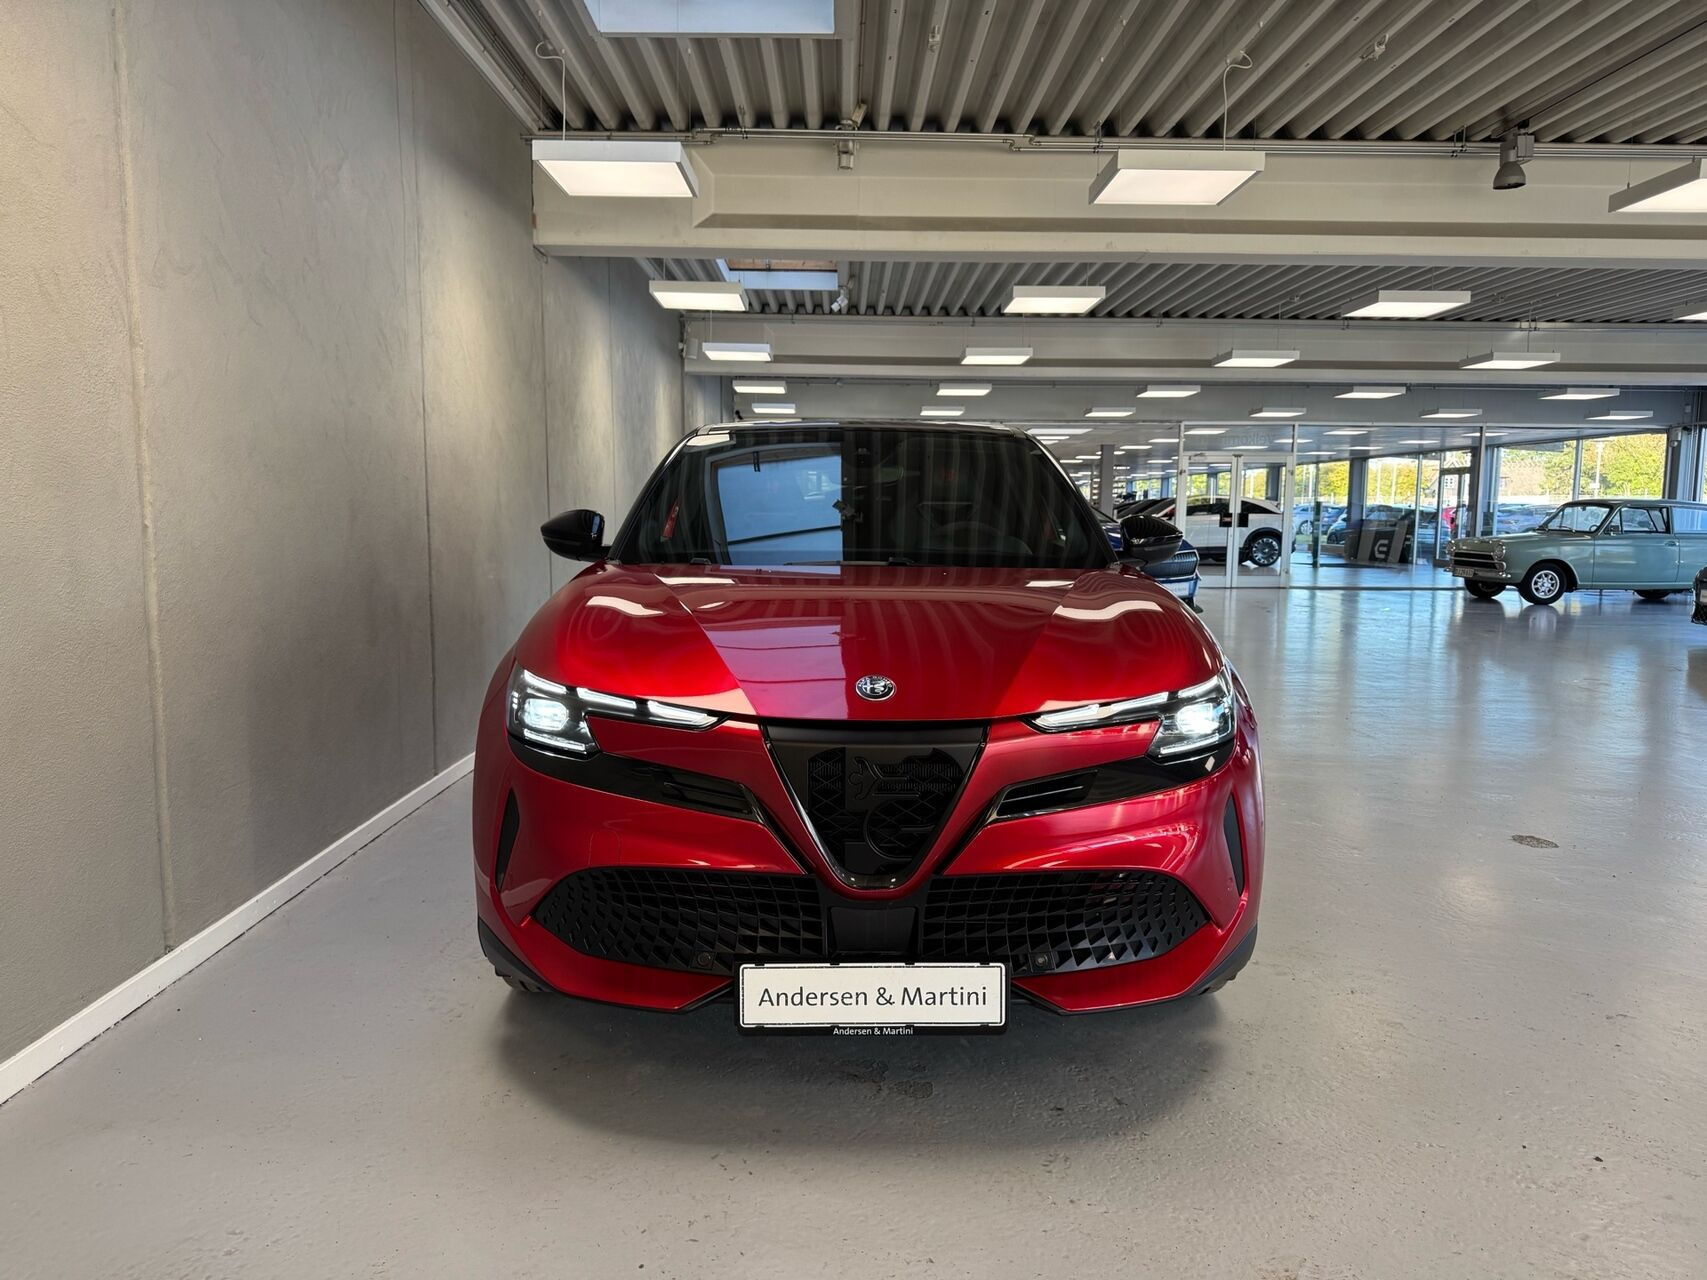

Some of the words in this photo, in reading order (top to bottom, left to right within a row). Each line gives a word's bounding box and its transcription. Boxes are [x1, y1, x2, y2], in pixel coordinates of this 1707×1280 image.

[758, 986, 868, 1007] Andersen
[875, 986, 896, 1006] &
[901, 986, 987, 1006] Martini
[832, 1027, 872, 1035] Andersen
[873, 1027, 881, 1035] &
[882, 1027, 914, 1035] Martini
